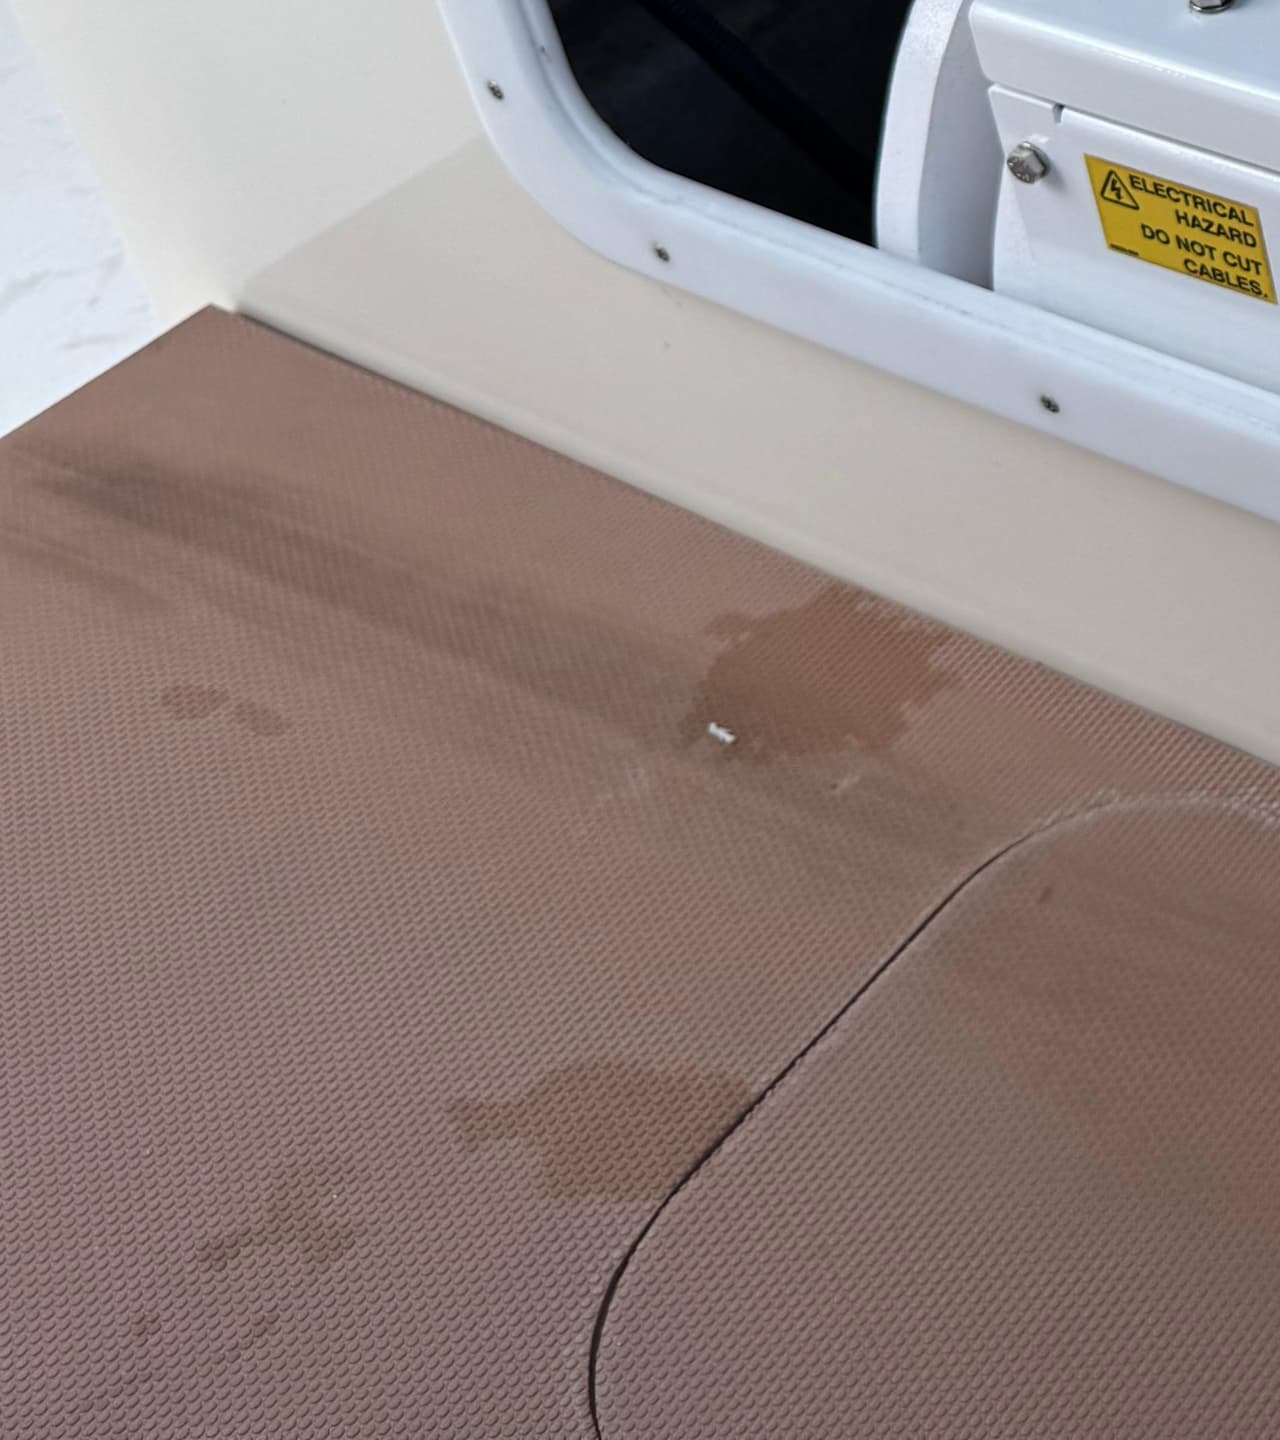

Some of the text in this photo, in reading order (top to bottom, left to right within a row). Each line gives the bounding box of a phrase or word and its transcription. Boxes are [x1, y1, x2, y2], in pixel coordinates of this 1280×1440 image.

[1129, 174, 1254, 227] ELECTRICAL
[1141, 223, 1262, 275] DO NOT CUT
[1175, 209, 1257, 248] HAZARD
[1184, 258, 1268, 298] CABLES.
